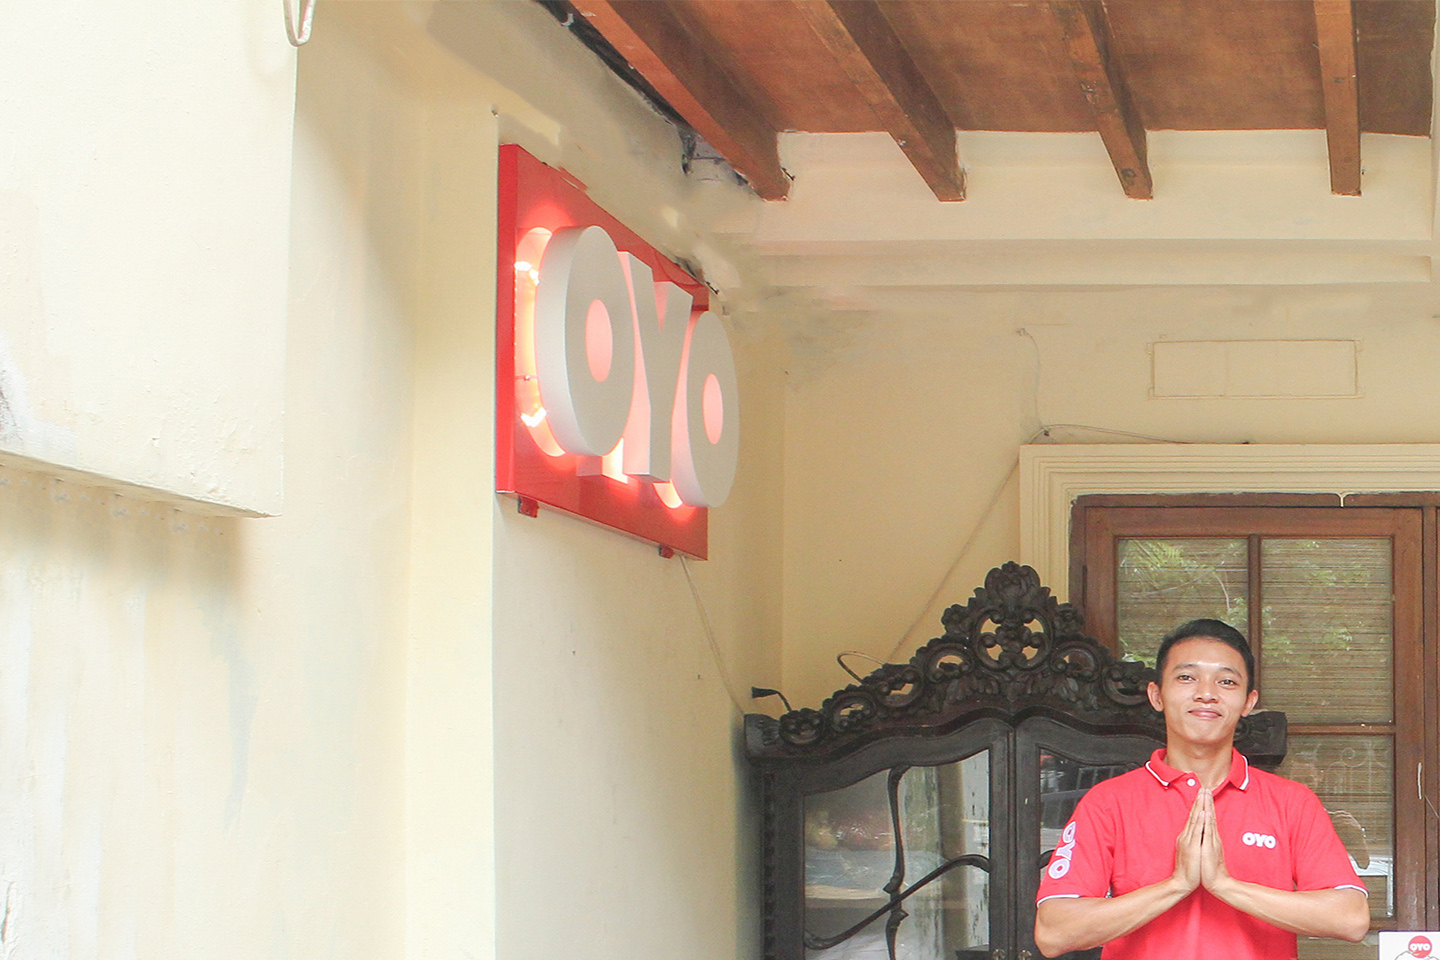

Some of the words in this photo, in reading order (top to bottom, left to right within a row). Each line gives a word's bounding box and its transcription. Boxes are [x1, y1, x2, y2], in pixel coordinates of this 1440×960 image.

[537, 225, 739, 508] OYO
[1048, 821, 1076, 879] OYO
[1242, 832, 1276, 849] OYO
[1409, 943, 1431, 951] OYO
